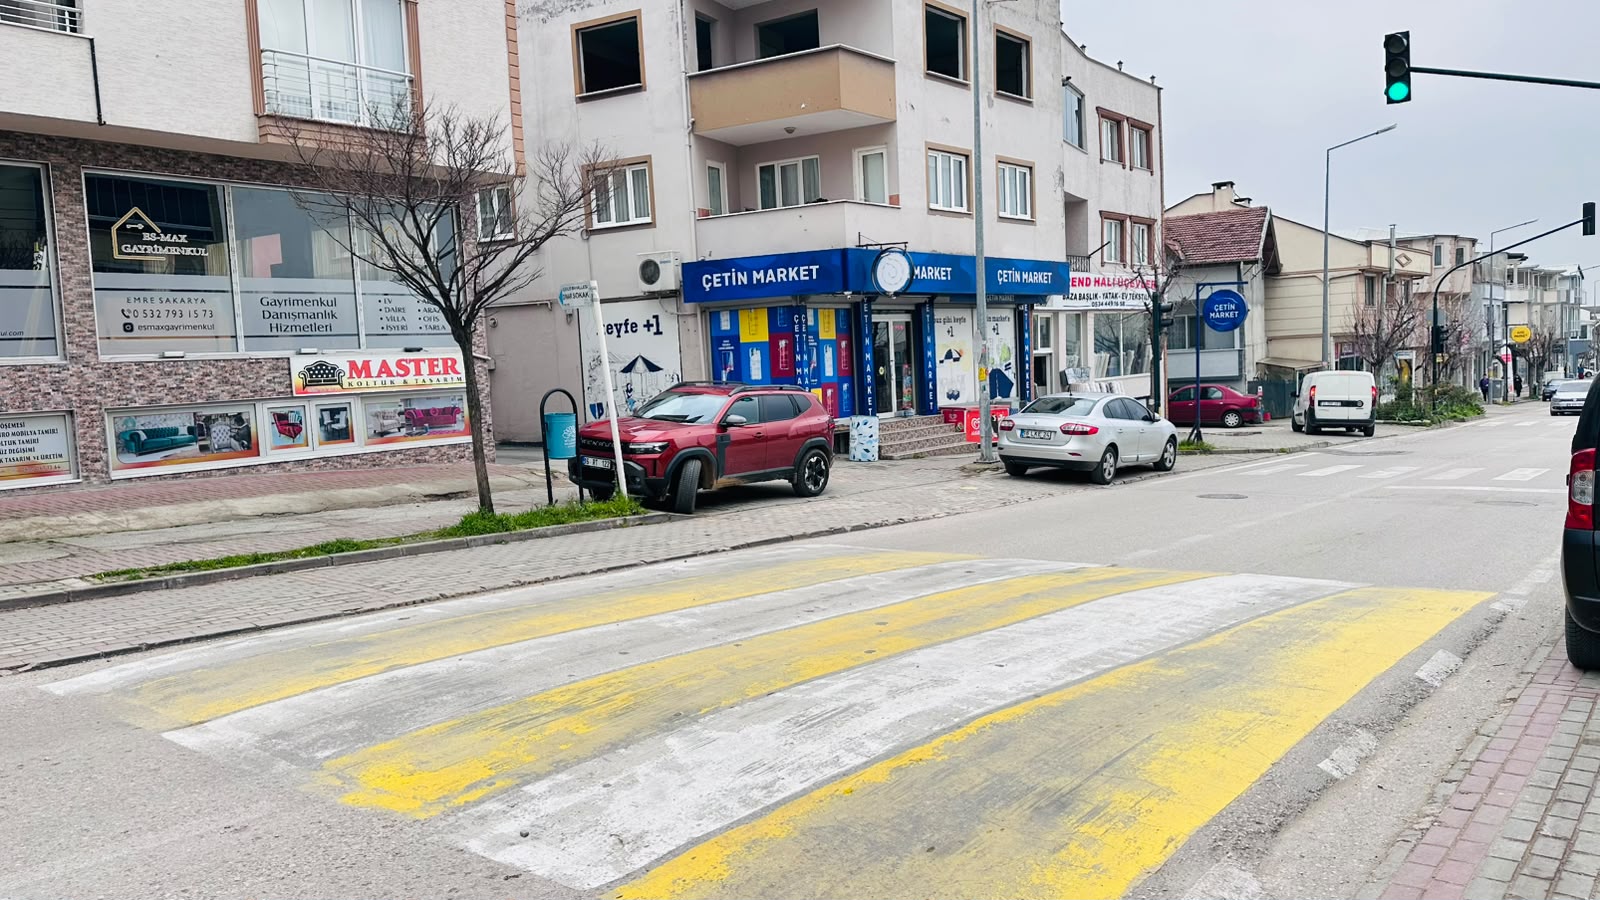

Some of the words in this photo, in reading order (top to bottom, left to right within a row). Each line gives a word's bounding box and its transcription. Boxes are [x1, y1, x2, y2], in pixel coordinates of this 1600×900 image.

[121, 244, 209, 256] GAYRİMENKUL
[702, 268, 748, 291] ÇETİN
[752, 265, 819, 285] MARKET
[913, 266, 952, 281] MARKET
[997, 267, 1020, 285] ÇETİN
[1022, 271, 1052, 284] MARKET
[1069, 277, 1091, 287] END
[260, 296, 337, 308] Gayrimenkul
[1078, 293, 1098, 302] BAŞLIK
[1102, 292, 1118, 300] YATAK
[1214, 302, 1235, 312] ÇETİN
[133, 309, 139, 318] 0
[142, 309, 162, 318] 532
[165, 309, 184, 318] 793
[188, 309, 199, 318] 15
[202, 309, 214, 318] 73
[262, 310, 338, 321] Danışmanlık
[1209, 311, 1239, 319] MARKET
[137, 323, 215, 331] esmaxgayrimenkul
[269, 322, 333, 332] Hizmetleri
[643, 314, 663, 336] +1
[346, 357, 461, 379] MASTER
[348, 379, 395, 387] KOLTUK
[865, 352, 873, 416] MARKET
[0, 421, 26, 430] ÖŞEMESİ
[11, 429, 37, 437] MOBİLYA
[37, 427, 59, 435] TAMİRİ
[18, 437, 39, 445] TAMİRİ
[40, 452, 63, 460] ÜRETİM
